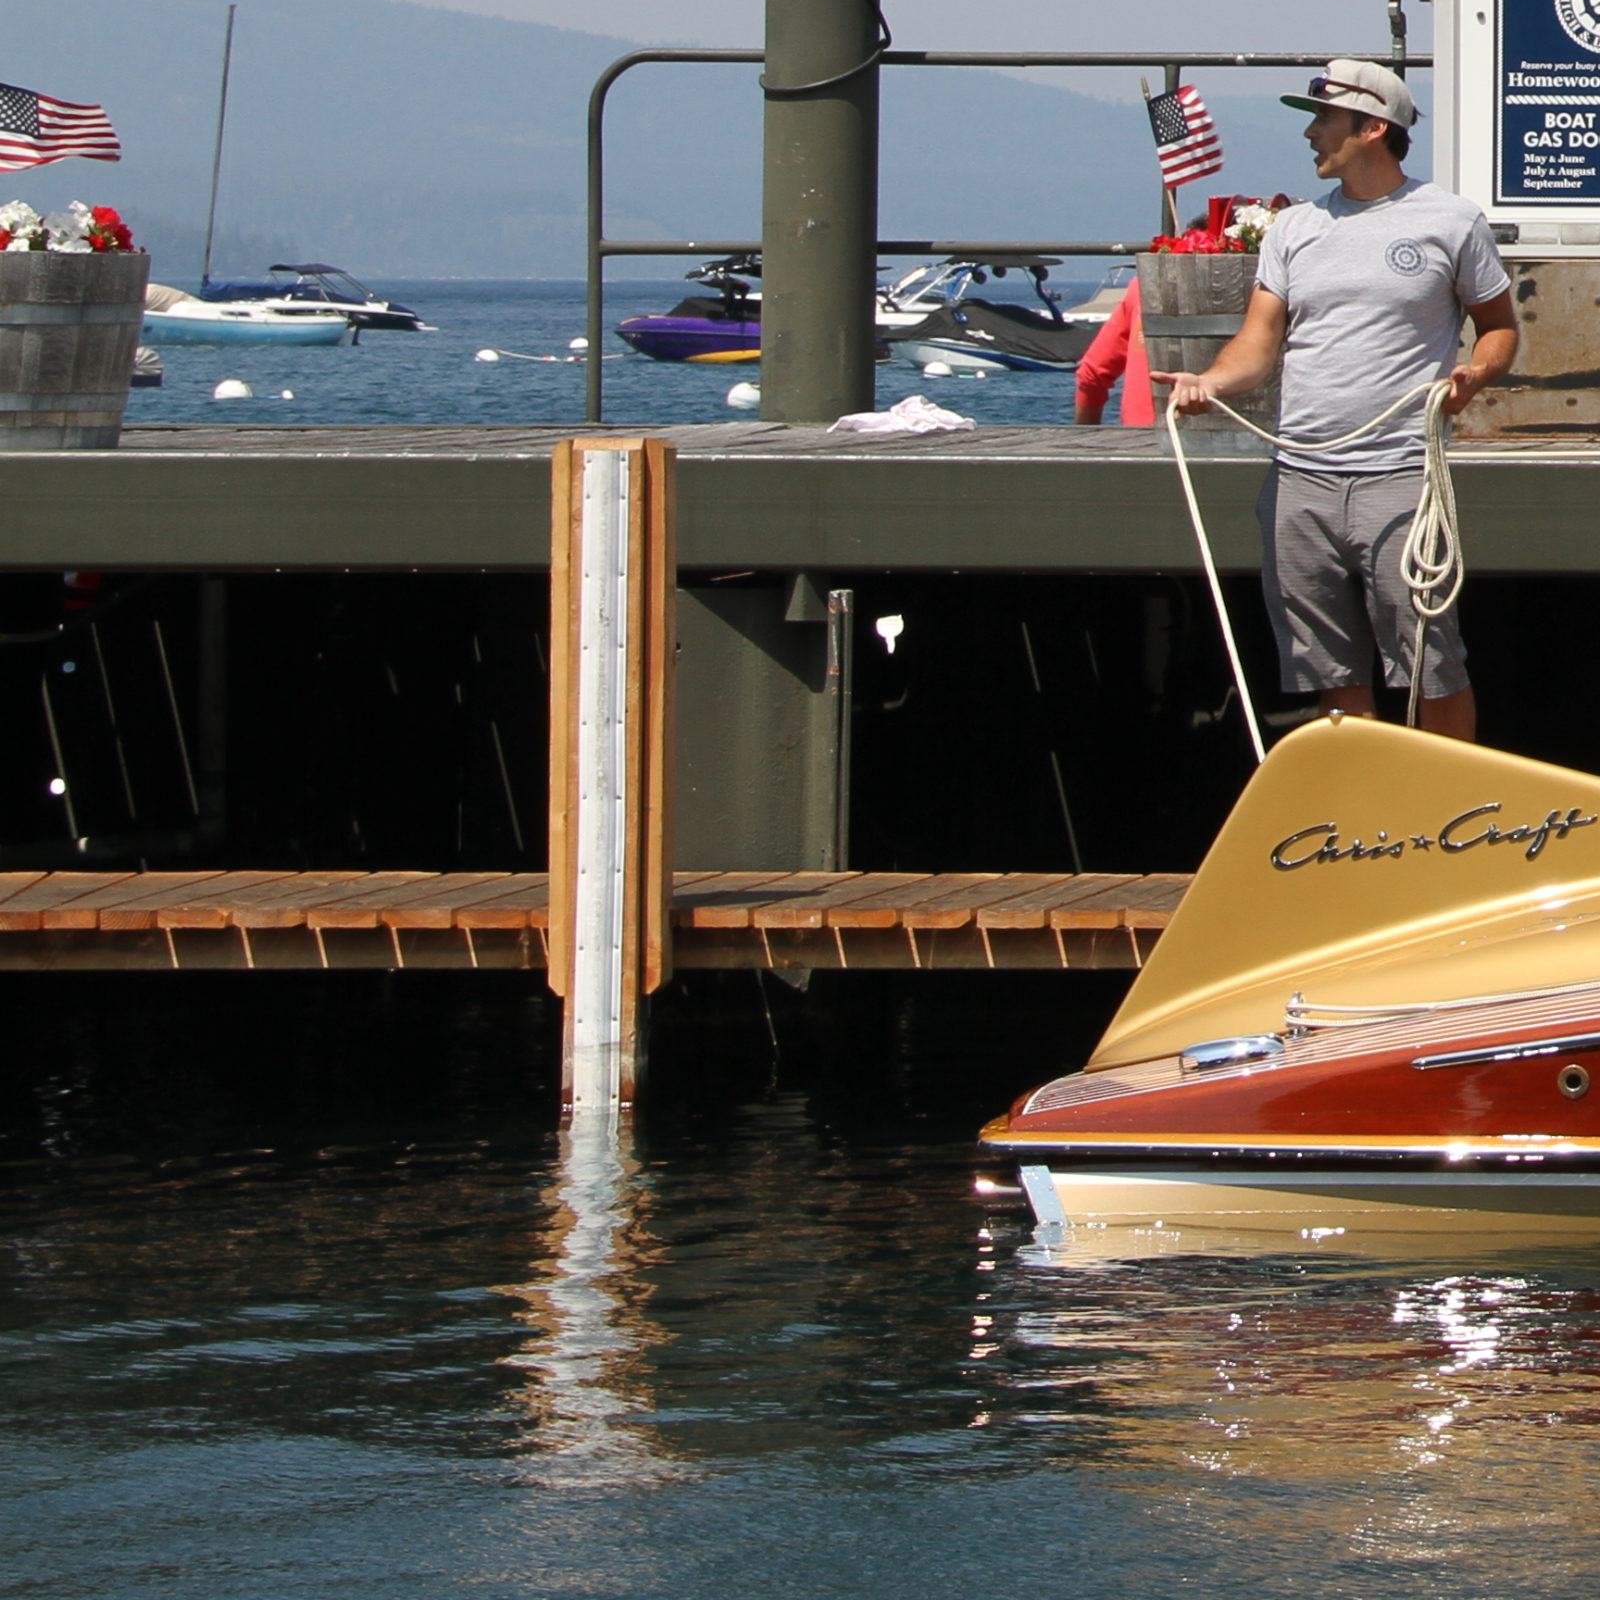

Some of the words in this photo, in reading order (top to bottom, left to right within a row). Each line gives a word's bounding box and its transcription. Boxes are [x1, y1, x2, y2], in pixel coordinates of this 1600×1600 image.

[1579, 31, 1591, 42] &
[1520, 60, 1553, 70] Reserve
[1553, 62, 1574, 72] your
[1575, 61, 1597, 72] buoy
[1544, 113, 1597, 129] BOAT
[1523, 132, 1563, 148] GAS
[1523, 153, 1548, 165] May
[1548, 155, 1557, 164] &
[1557, 153, 1586, 164] June
[1523, 165, 1548, 178] July
[1548, 167, 1557, 176] &
[1557, 166, 1597, 178] August
[1523, 178, 1583, 191] September
